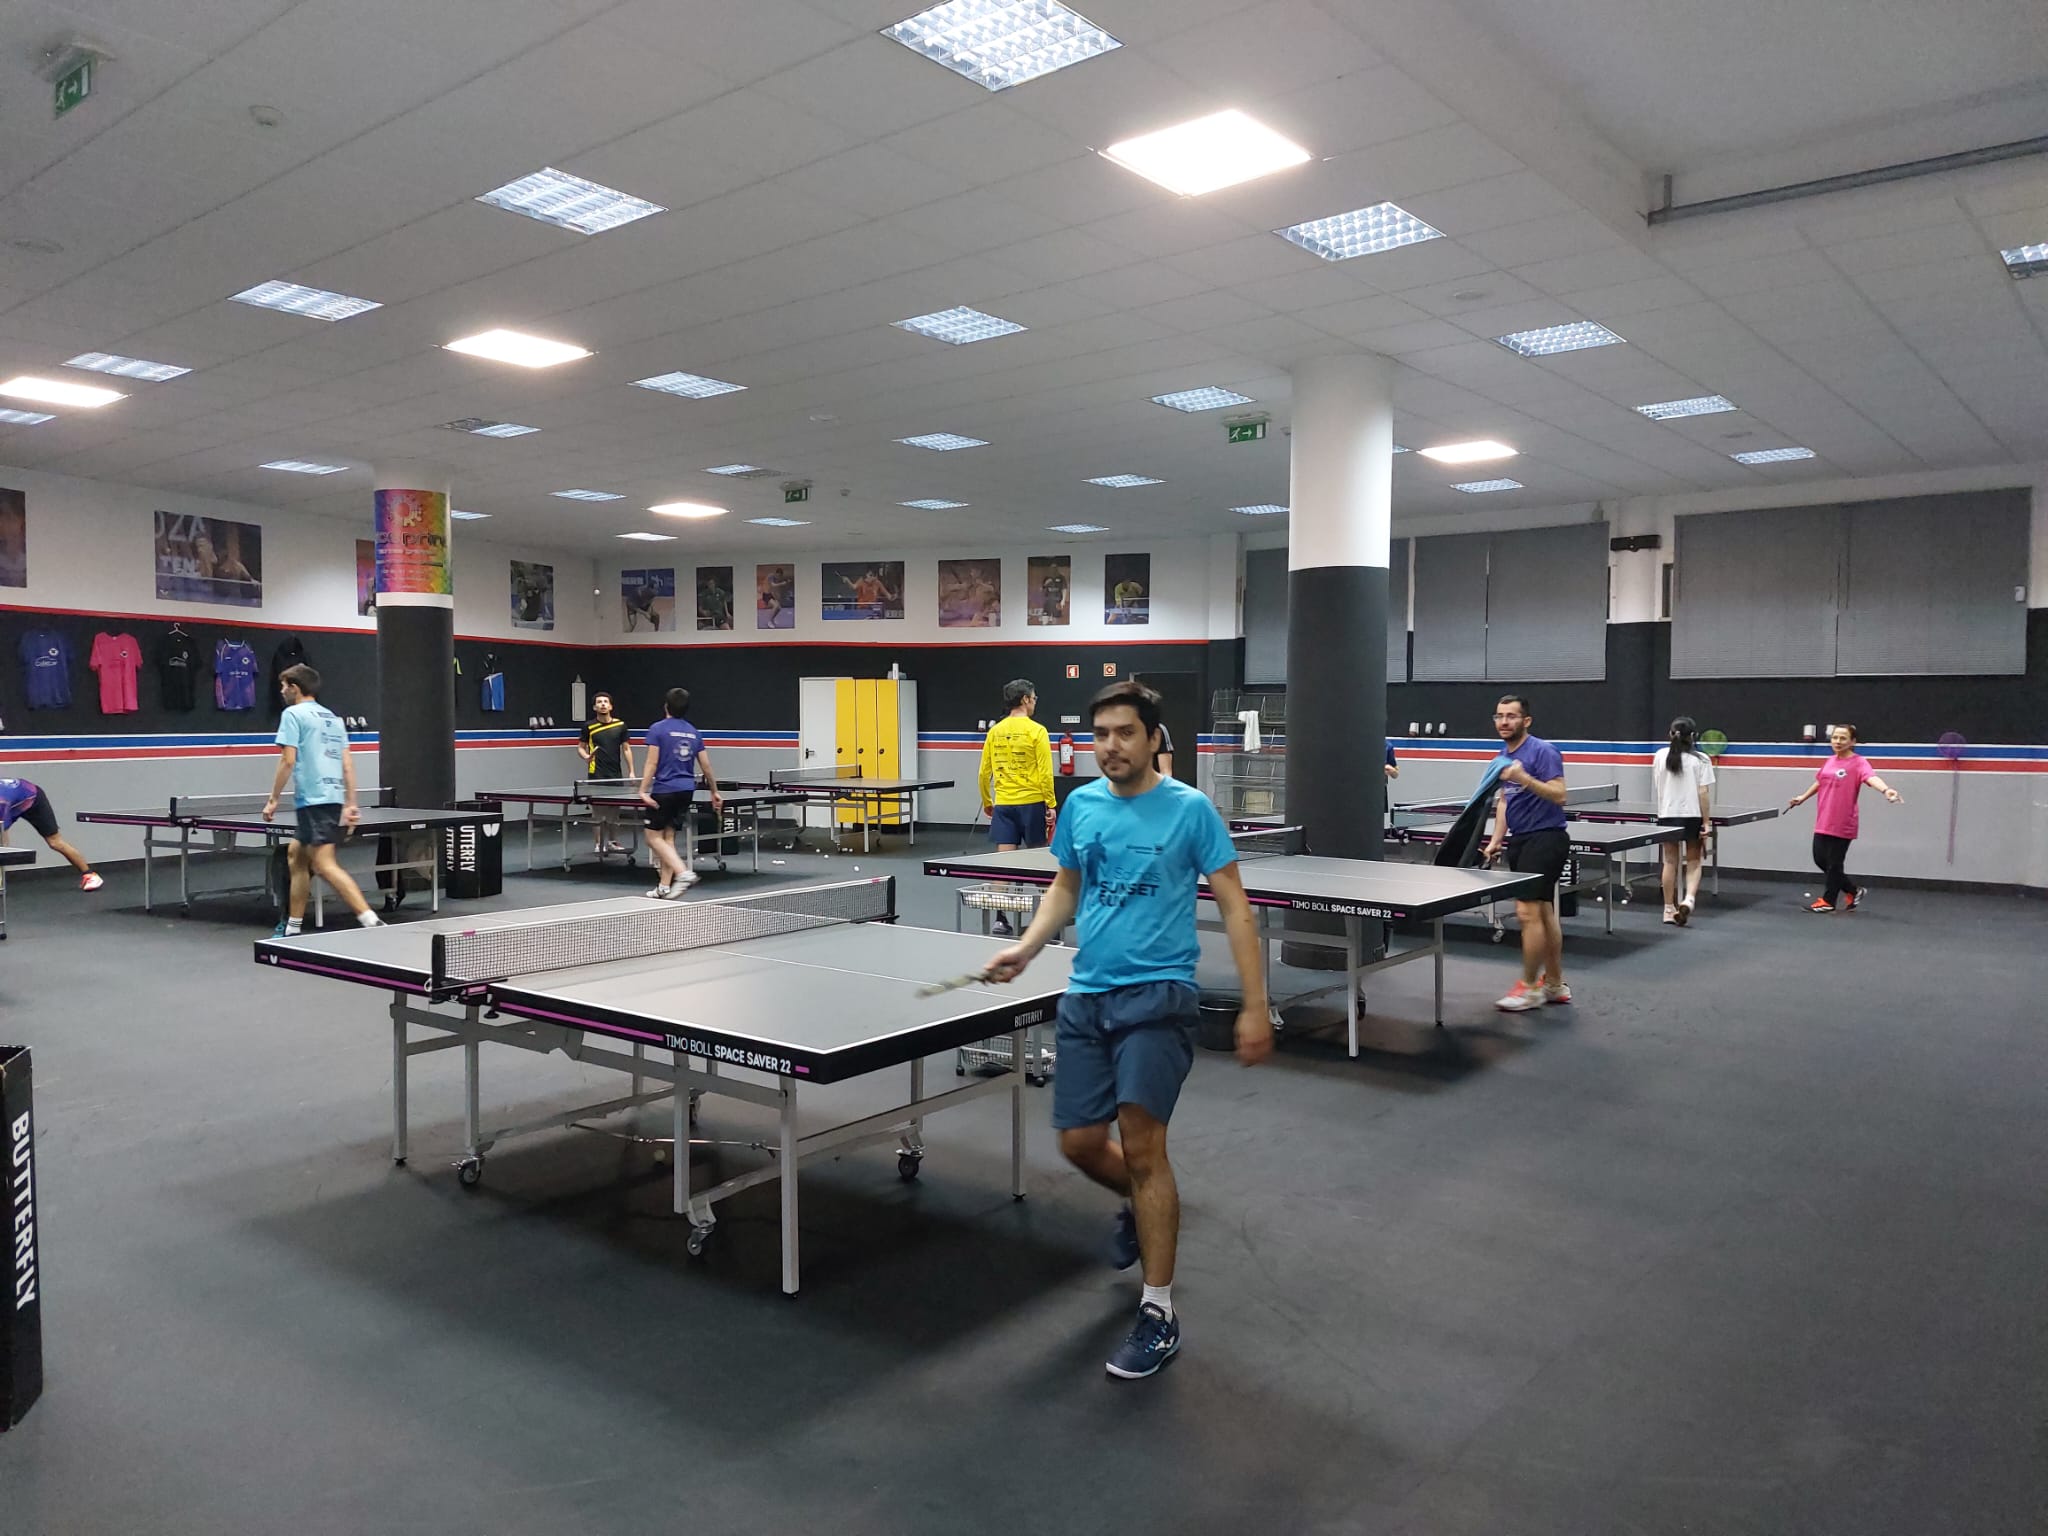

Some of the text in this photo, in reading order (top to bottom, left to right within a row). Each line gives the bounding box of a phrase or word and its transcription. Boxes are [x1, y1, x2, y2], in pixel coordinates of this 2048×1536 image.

[1292, 900, 1392, 919] TIMO BOLL SPACE SAVER 22
[1014, 1009, 1044, 1028] BUTTERFLY
[665, 1033, 792, 1074] TIMO BOLL SPACE SAVER 22
[12, 1110, 35, 1311] BUTTERFLY
